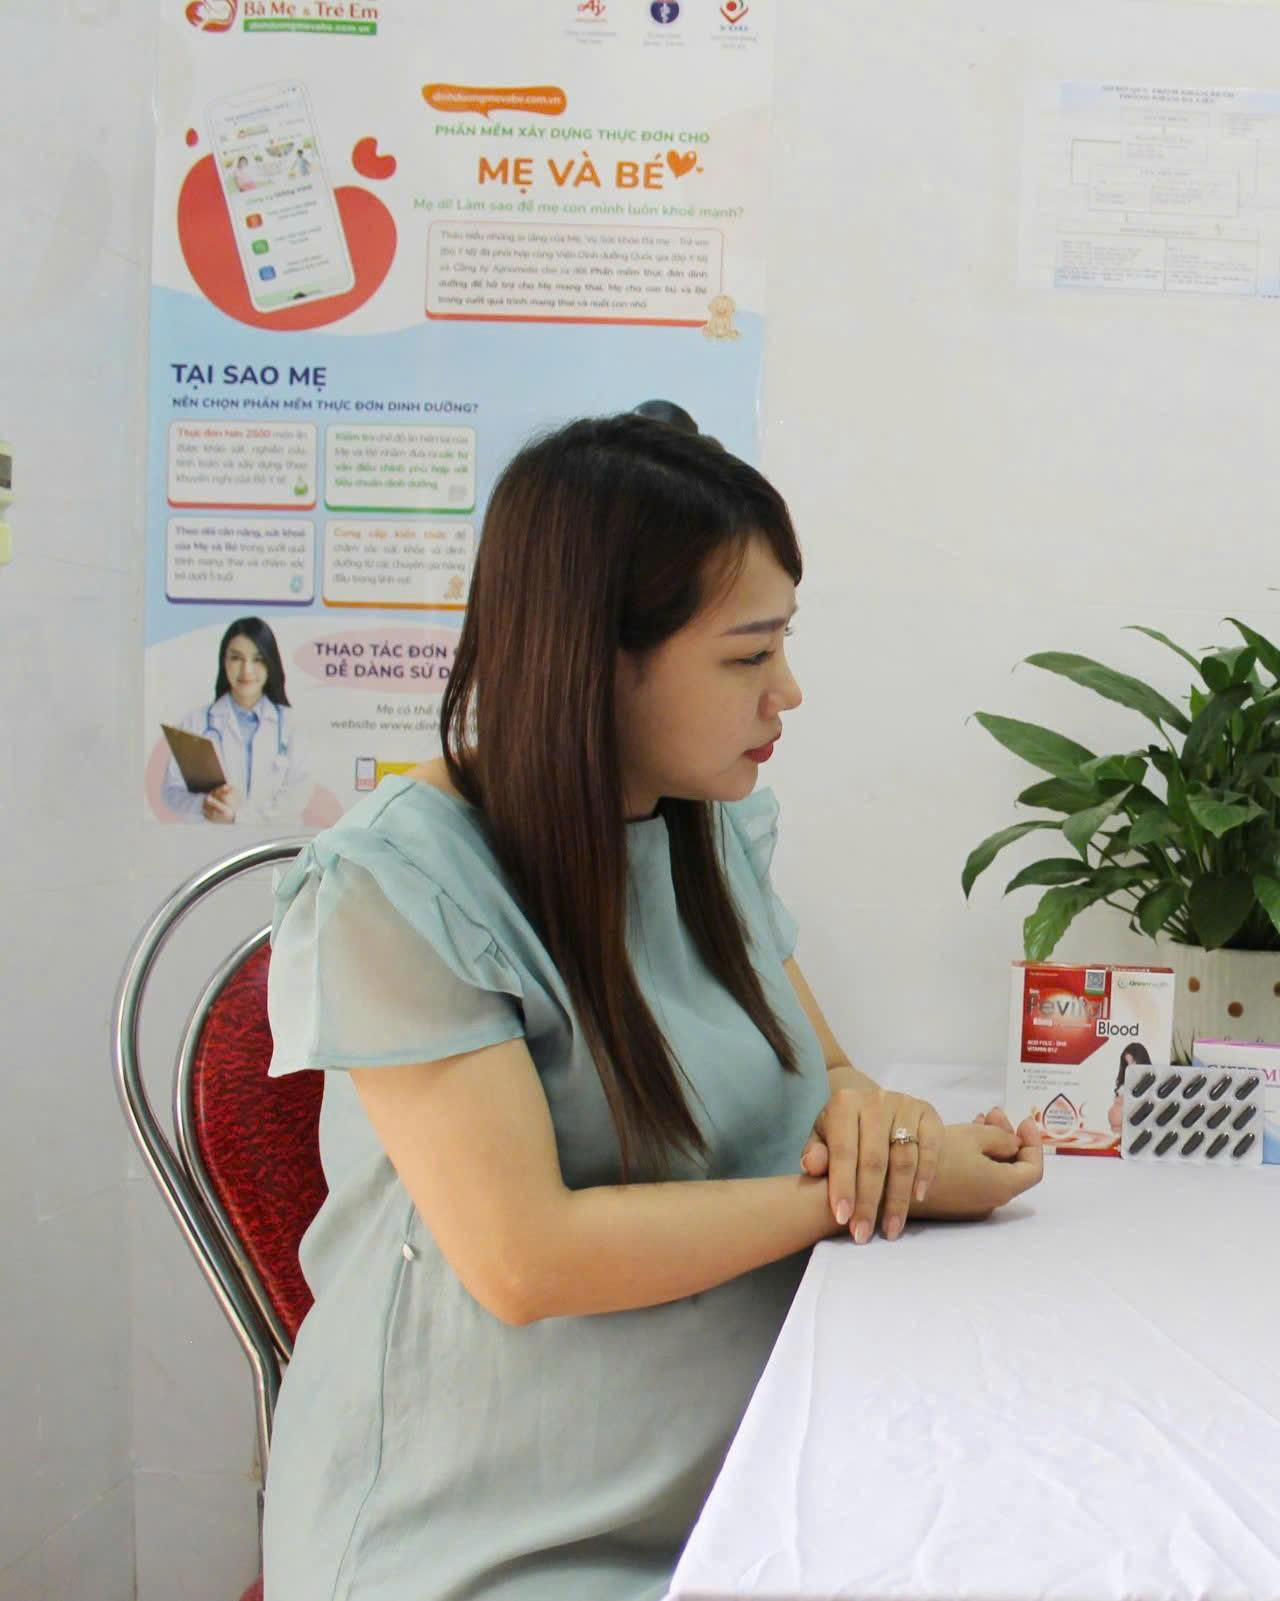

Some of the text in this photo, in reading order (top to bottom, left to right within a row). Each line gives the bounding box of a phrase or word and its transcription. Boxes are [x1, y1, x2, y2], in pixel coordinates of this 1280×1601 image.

[349, 2, 378, 18] Em
[434, 123, 710, 144] PHẦN MỀM XÂY DỰNG THỰC ĐƠN CHO
[477, 151, 664, 194] MẸ VÀ BÉ
[170, 363, 327, 392] TẠI SAO MẸ
[172, 396, 479, 415] NÊN CHỌN PHẦN MỀM THỰC ĐƠN DINH DƯỠNG?
[315, 639, 447, 658] THAO TÁC ĐƠN
[325, 659, 433, 679] DỄ DÀNG SỬ
[330, 719, 376, 731] website
[1098, 1021, 1139, 1036] Blood
